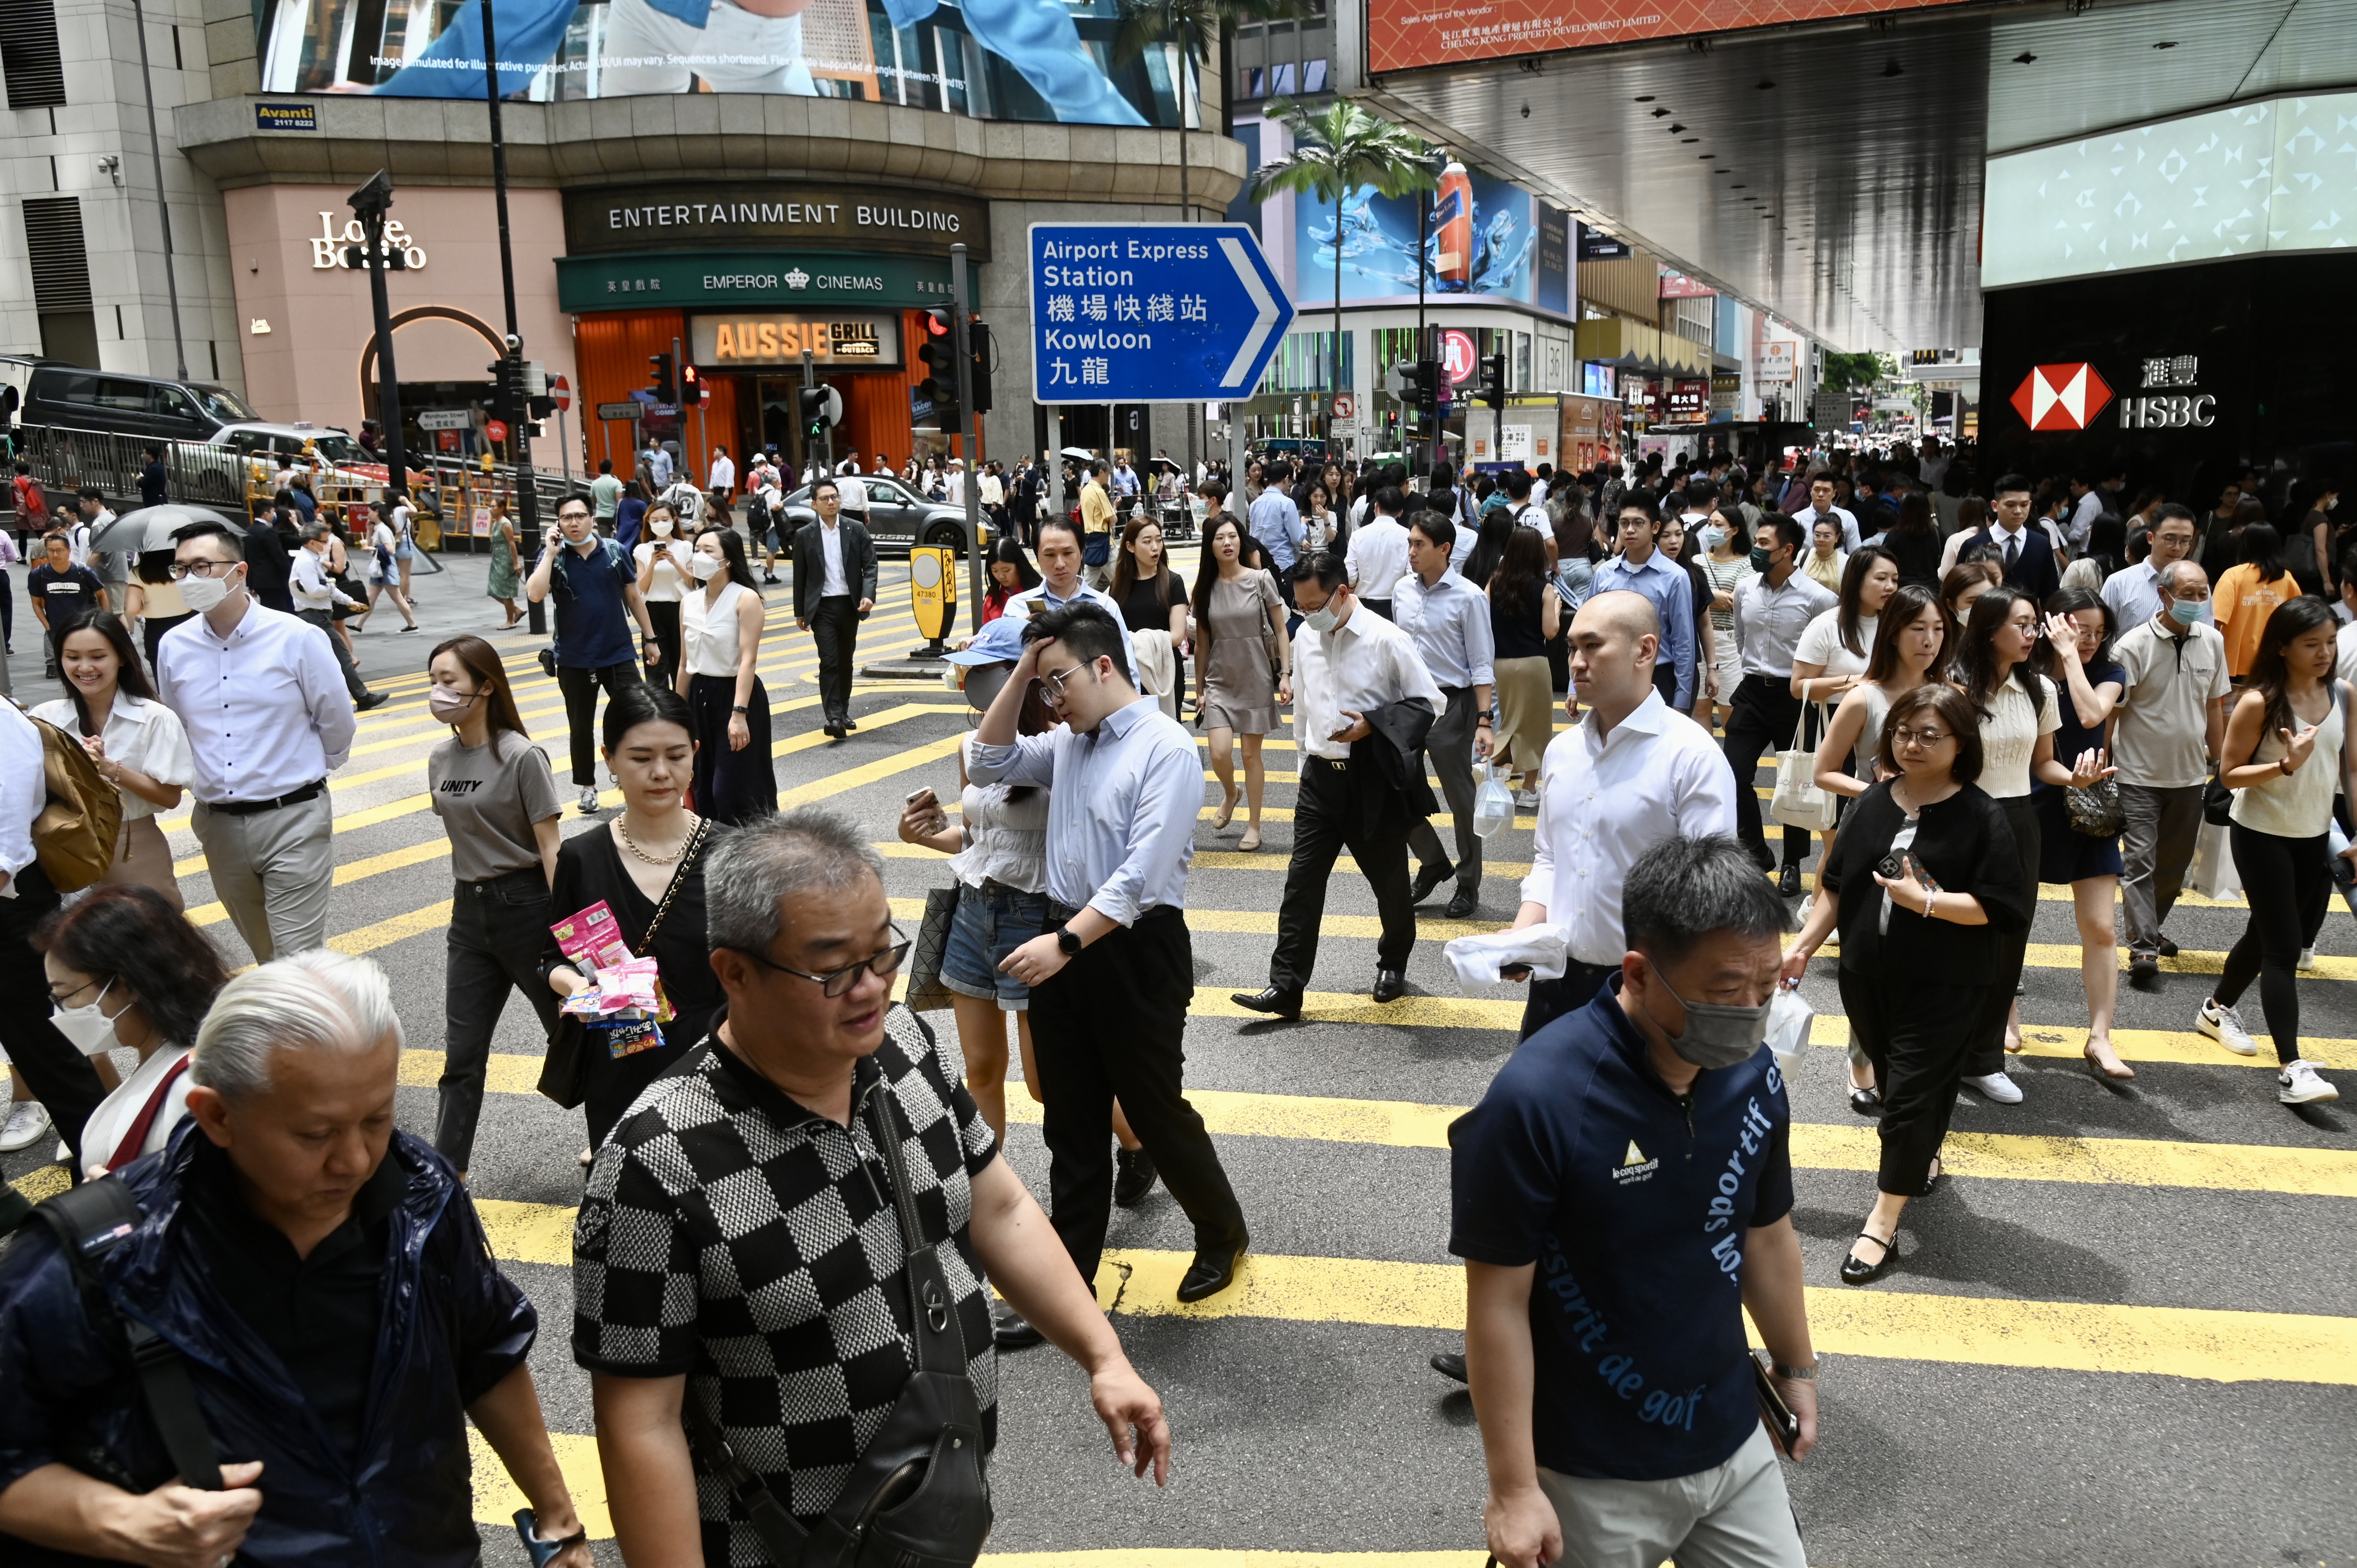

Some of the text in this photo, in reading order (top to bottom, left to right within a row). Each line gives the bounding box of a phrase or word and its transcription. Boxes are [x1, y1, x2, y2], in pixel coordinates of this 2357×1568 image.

[1401, 16, 1420, 25] Sales
[1422, 12, 1443, 24] Agent
[1445, 10, 1452, 19] of
[1453, 9, 1466, 18] the
[1467, 7, 1493, 16] Vendor
[1441, 15, 1661, 50] CHEUNG KONG PROPERTY DEVELOPMENT LIMITED
[370, 55, 402, 69] Image
[455, 58, 469, 70] for
[470, 59, 523, 72] illurative
[624, 58, 642, 67] may
[643, 56, 665, 66] vary.
[666, 54, 717, 66] Sequences
[718, 53, 769, 65] shortened.
[770, 55, 790, 65] Flex
[819, 60, 863, 73] supported
[864, 63, 872, 73] at
[259, 107, 313, 118] Avanti
[609, 203, 960, 233] ENTERTAINMENT BUILDING
[318, 212, 412, 247] Loe,
[1043, 240, 1209, 262] Airport Express
[607, 279, 661, 293] 英皇戲院
[703, 275, 883, 291] EMPEROR CINEMAS
[1044, 265, 1133, 287] Station
[1047, 293, 1207, 322] 機場快綫站
[716, 322, 879, 357] AUSSIE GRILL
[1045, 329, 1151, 350] Kowloon
[1049, 356, 1110, 385] 九龍
[1550, 347, 1560, 378] 36
[2119, 394, 2216, 428] HSBC
[47, 582, 80, 591] ENGINEERING
[440, 780, 484, 792] UNITY
[1612, 1157, 1659, 1179] le coq sportif
[1705, 1097, 1773, 1233] sportif
[1619, 1176, 1635, 1185] esprit
[1642, 1171, 1652, 1181] golf
[1543, 1234, 1707, 1431] esprit de golf
